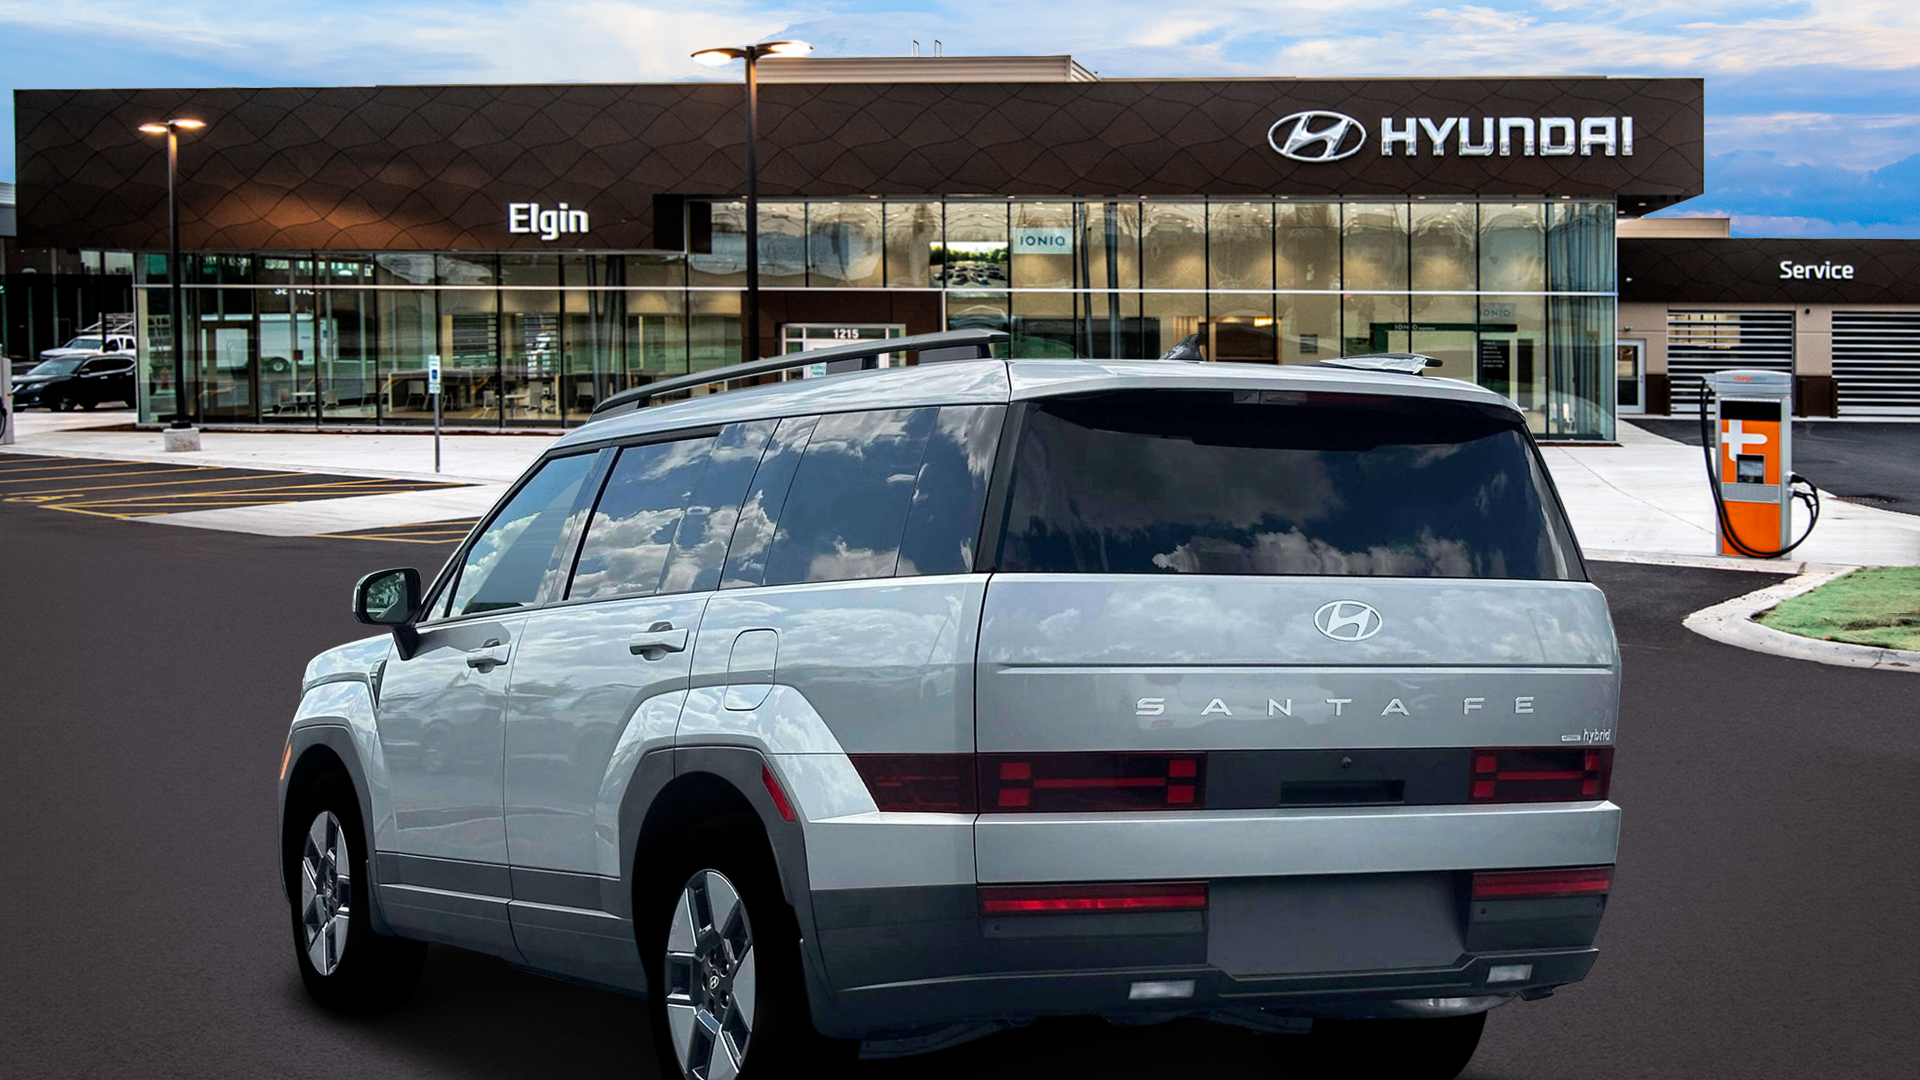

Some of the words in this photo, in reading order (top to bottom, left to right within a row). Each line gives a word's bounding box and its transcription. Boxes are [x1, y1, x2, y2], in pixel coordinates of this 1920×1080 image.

[1381, 116, 1634, 156] HYUNDAI
[508, 202, 589, 241] Elgin
[1020, 236, 1065, 246] IONIQ
[1779, 260, 1854, 279] Service
[833, 328, 859, 339] 1215
[1135, 696, 1410, 717] SANTA
[1462, 695, 1536, 715] FE
[1583, 728, 1611, 744] hybrid
